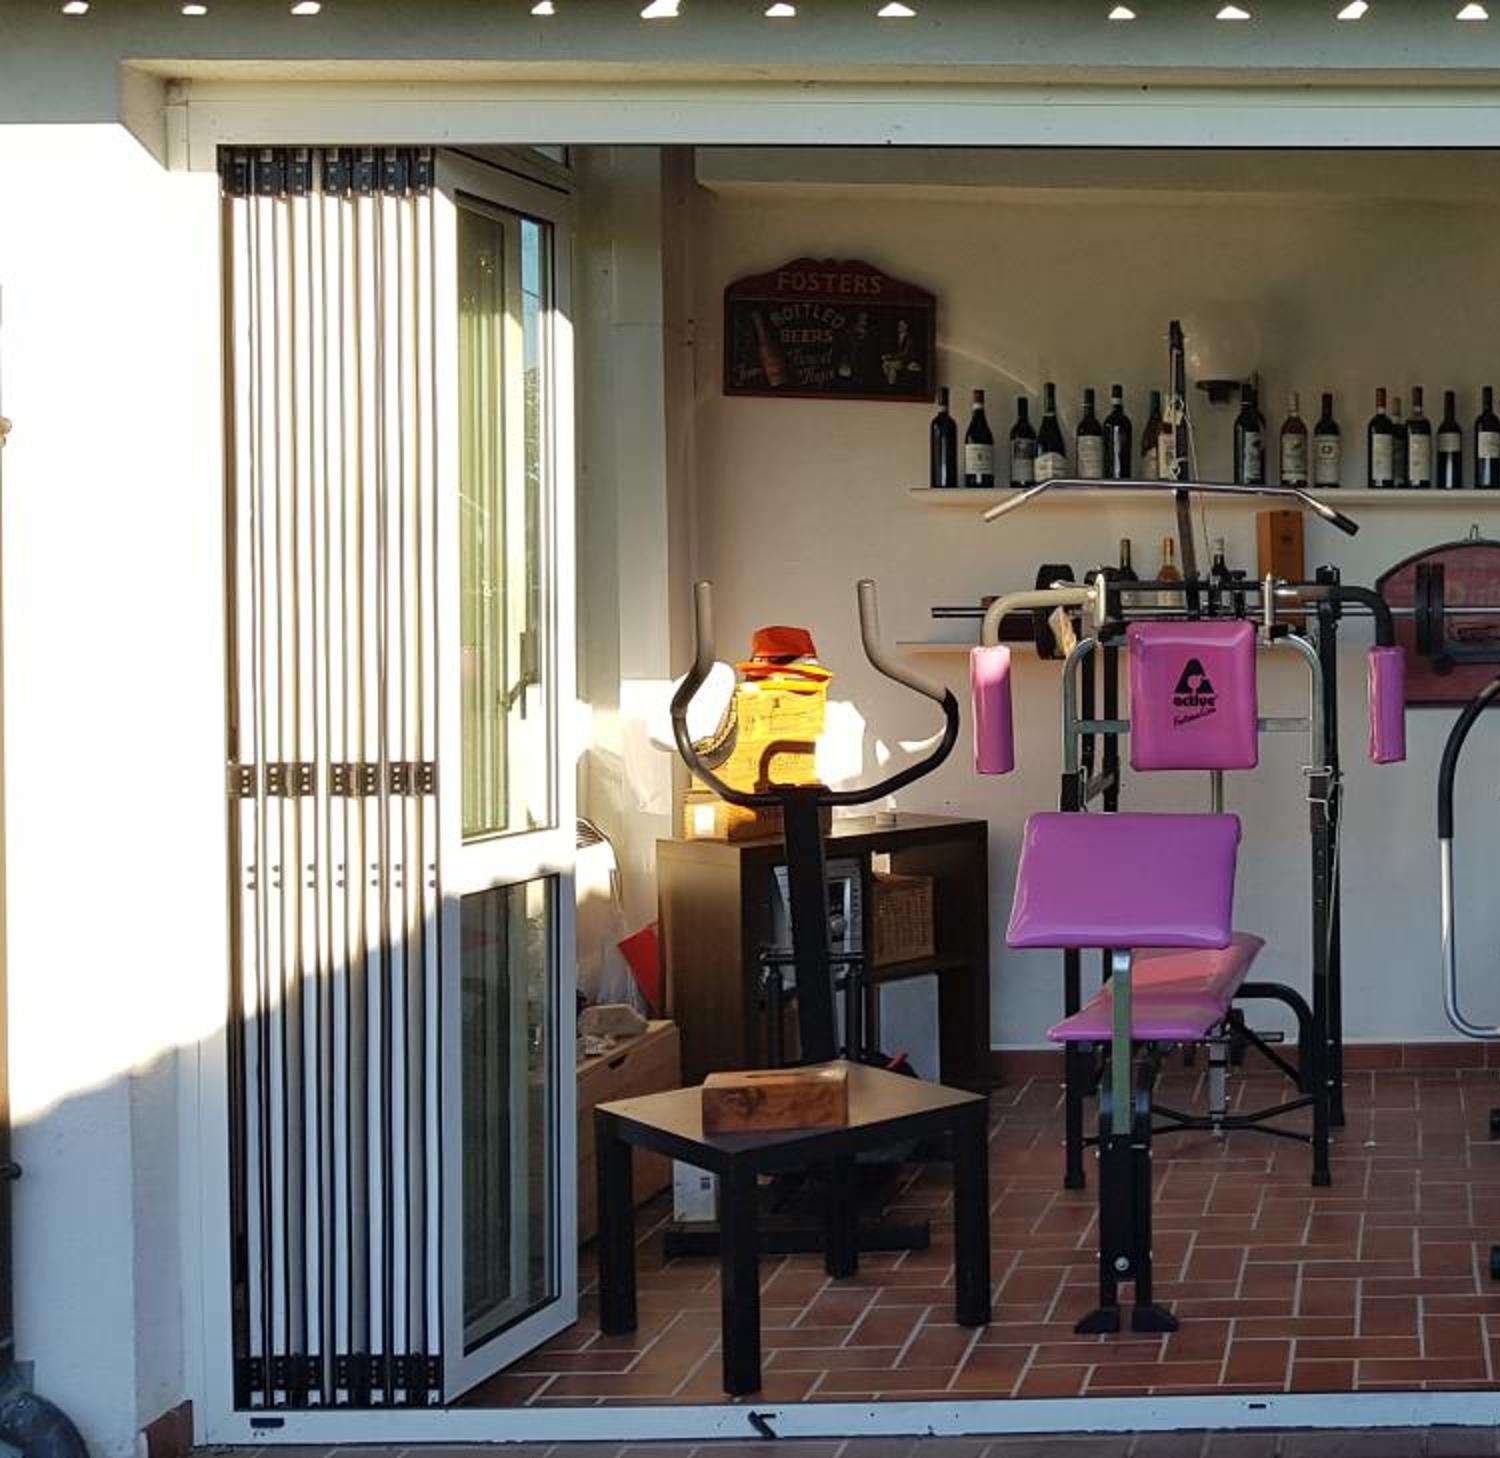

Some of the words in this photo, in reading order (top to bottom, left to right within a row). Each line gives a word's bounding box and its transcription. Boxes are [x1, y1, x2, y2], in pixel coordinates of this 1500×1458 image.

[775, 271, 881, 295] FOSTERS
[781, 328, 832, 344] BEERS
[1173, 694, 1215, 706] active
